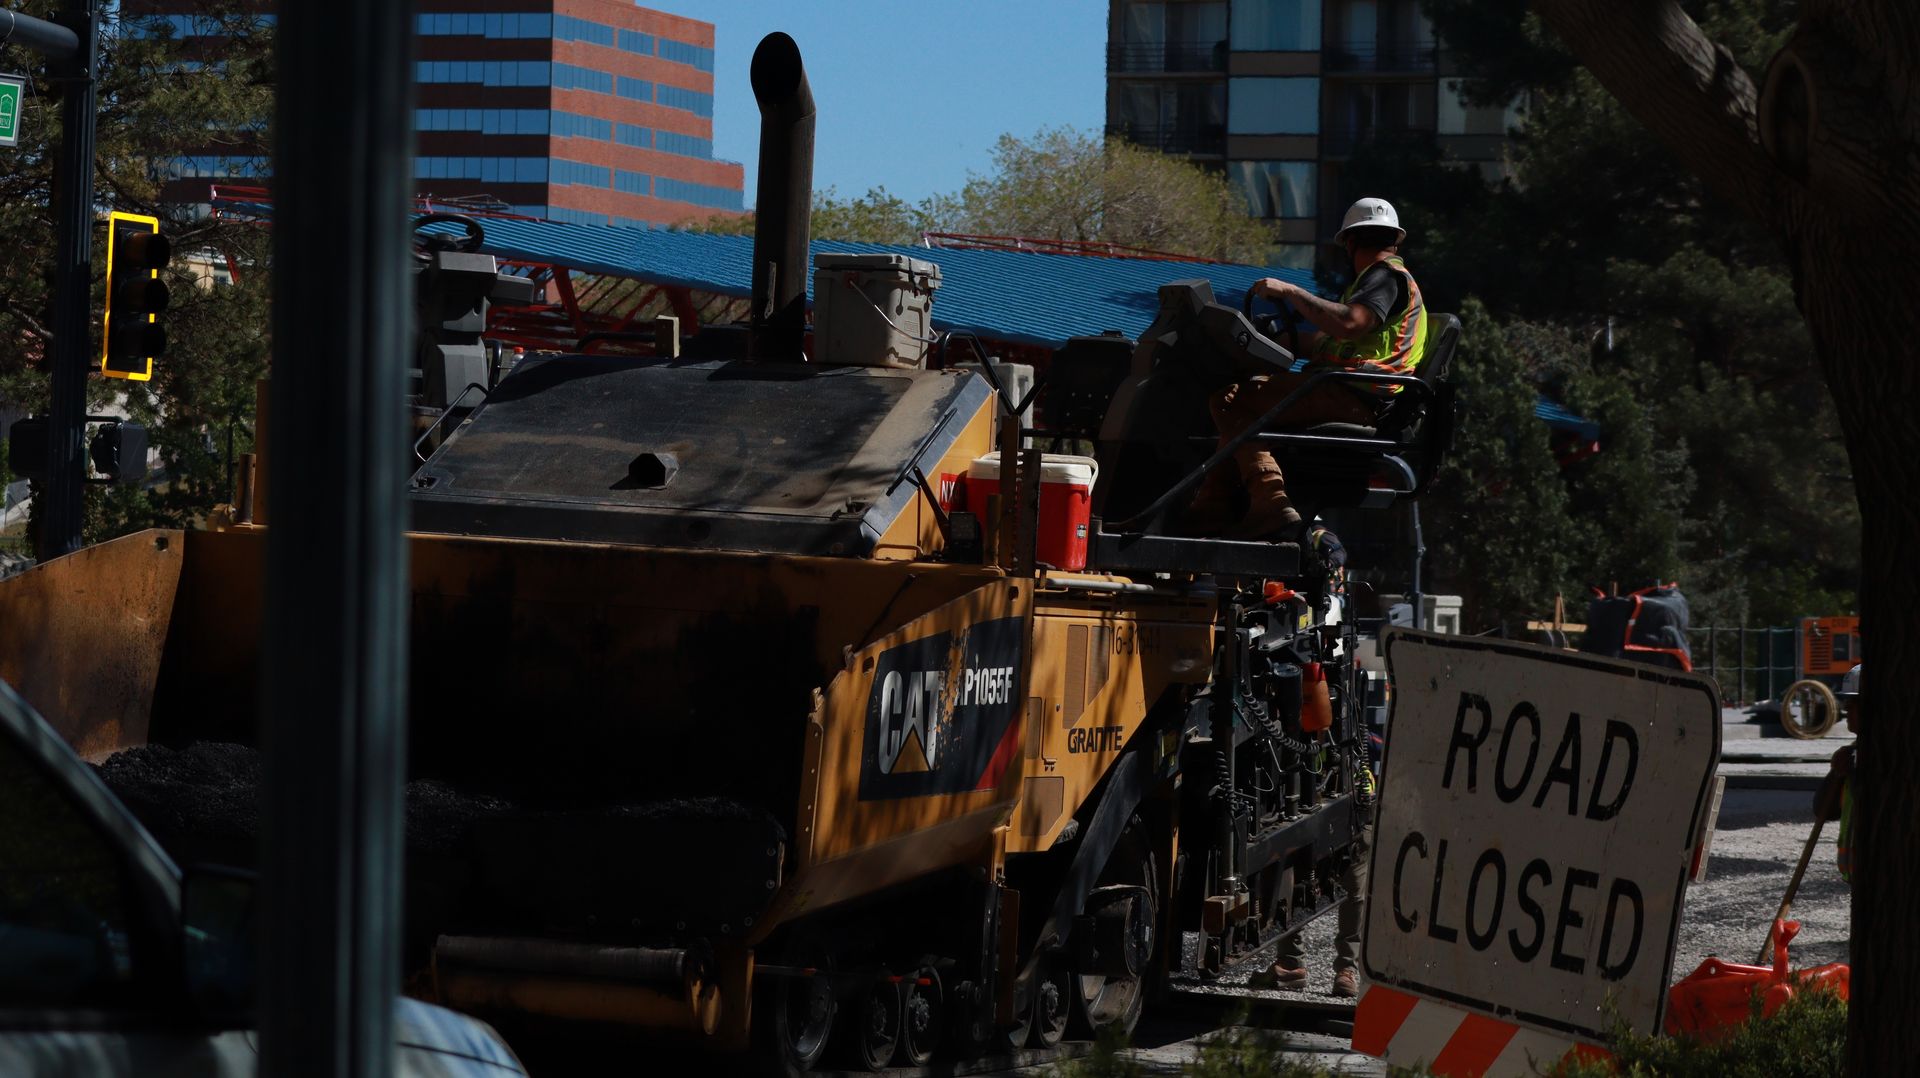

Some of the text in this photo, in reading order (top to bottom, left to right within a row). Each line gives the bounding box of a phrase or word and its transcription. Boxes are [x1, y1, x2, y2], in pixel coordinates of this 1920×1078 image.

[878, 670, 945, 774] CAT
[1067, 726, 1122, 753] GRANITE
[1442, 692, 1639, 820] ROAD
[1393, 831, 1644, 982] CLOSED
